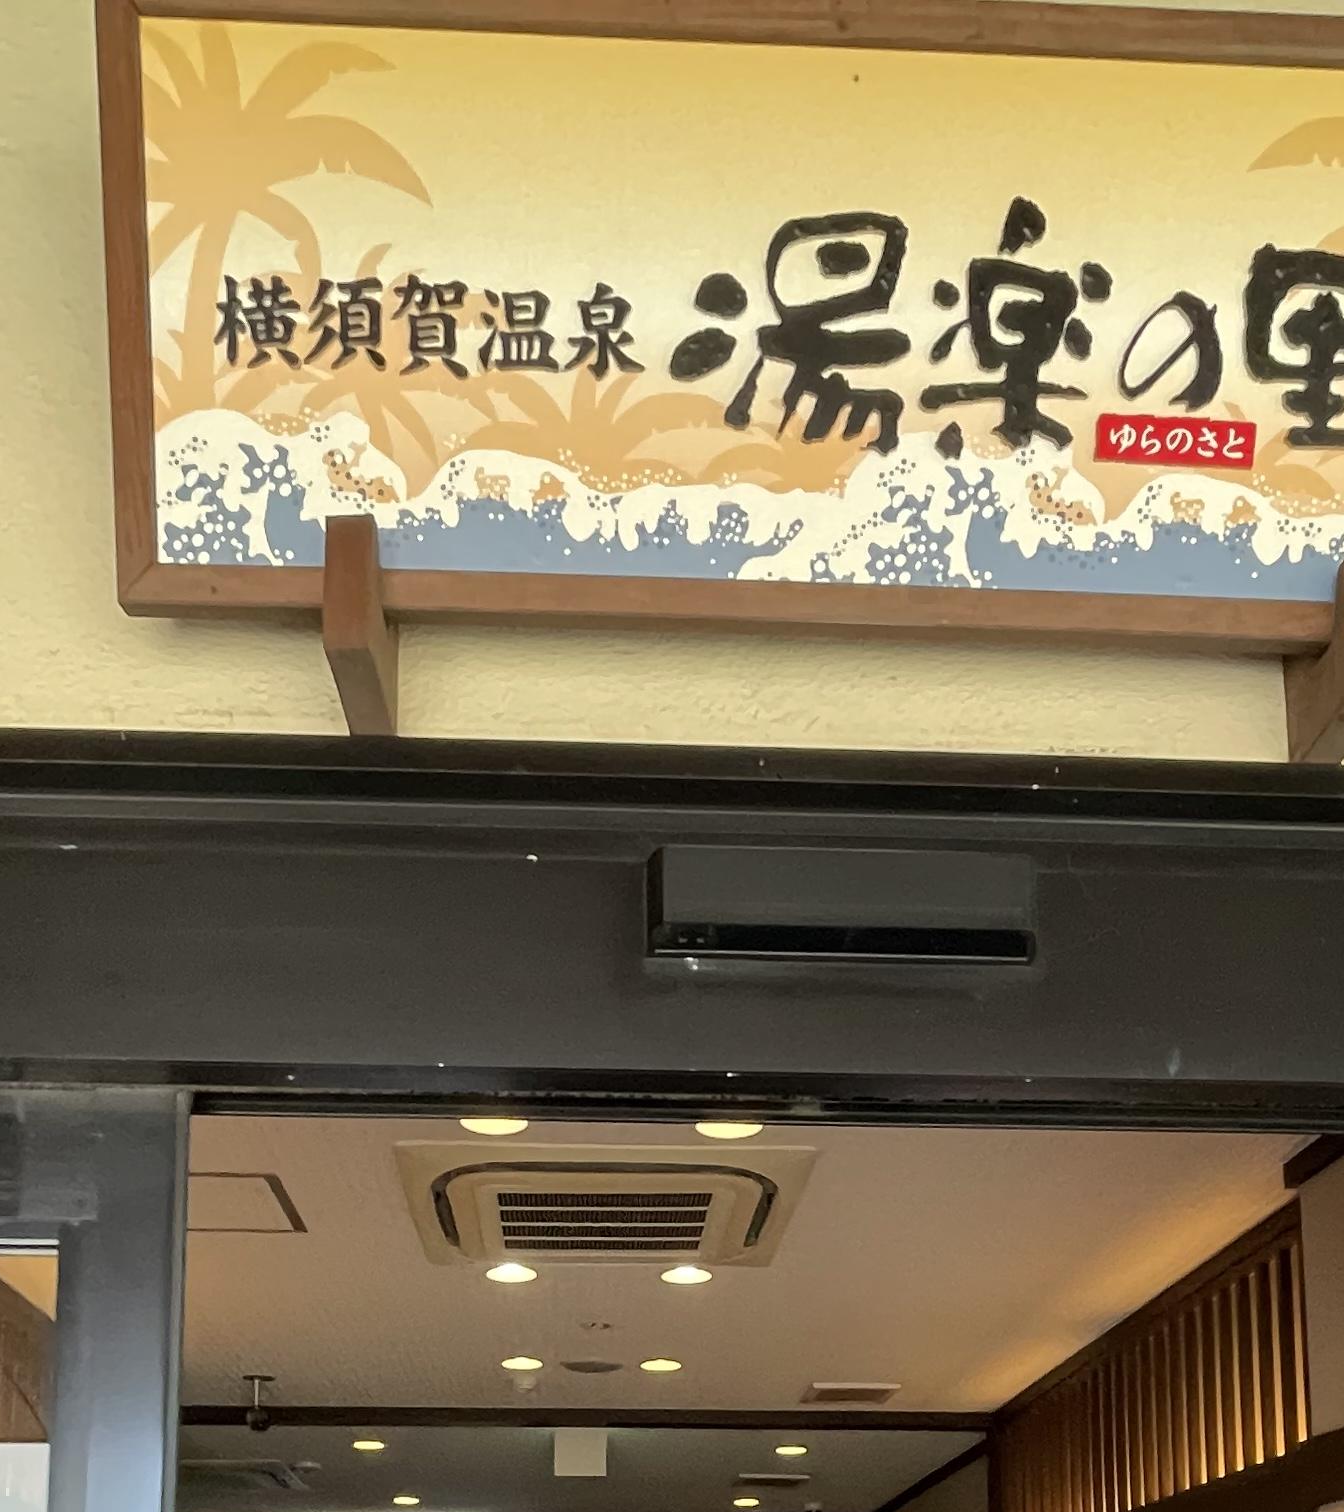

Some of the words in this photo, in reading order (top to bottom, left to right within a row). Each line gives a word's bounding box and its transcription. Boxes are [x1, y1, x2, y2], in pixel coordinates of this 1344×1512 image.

[213, 275, 648, 378] 横須賀温泉
[1106, 422, 1247, 463] ゆらのさと
